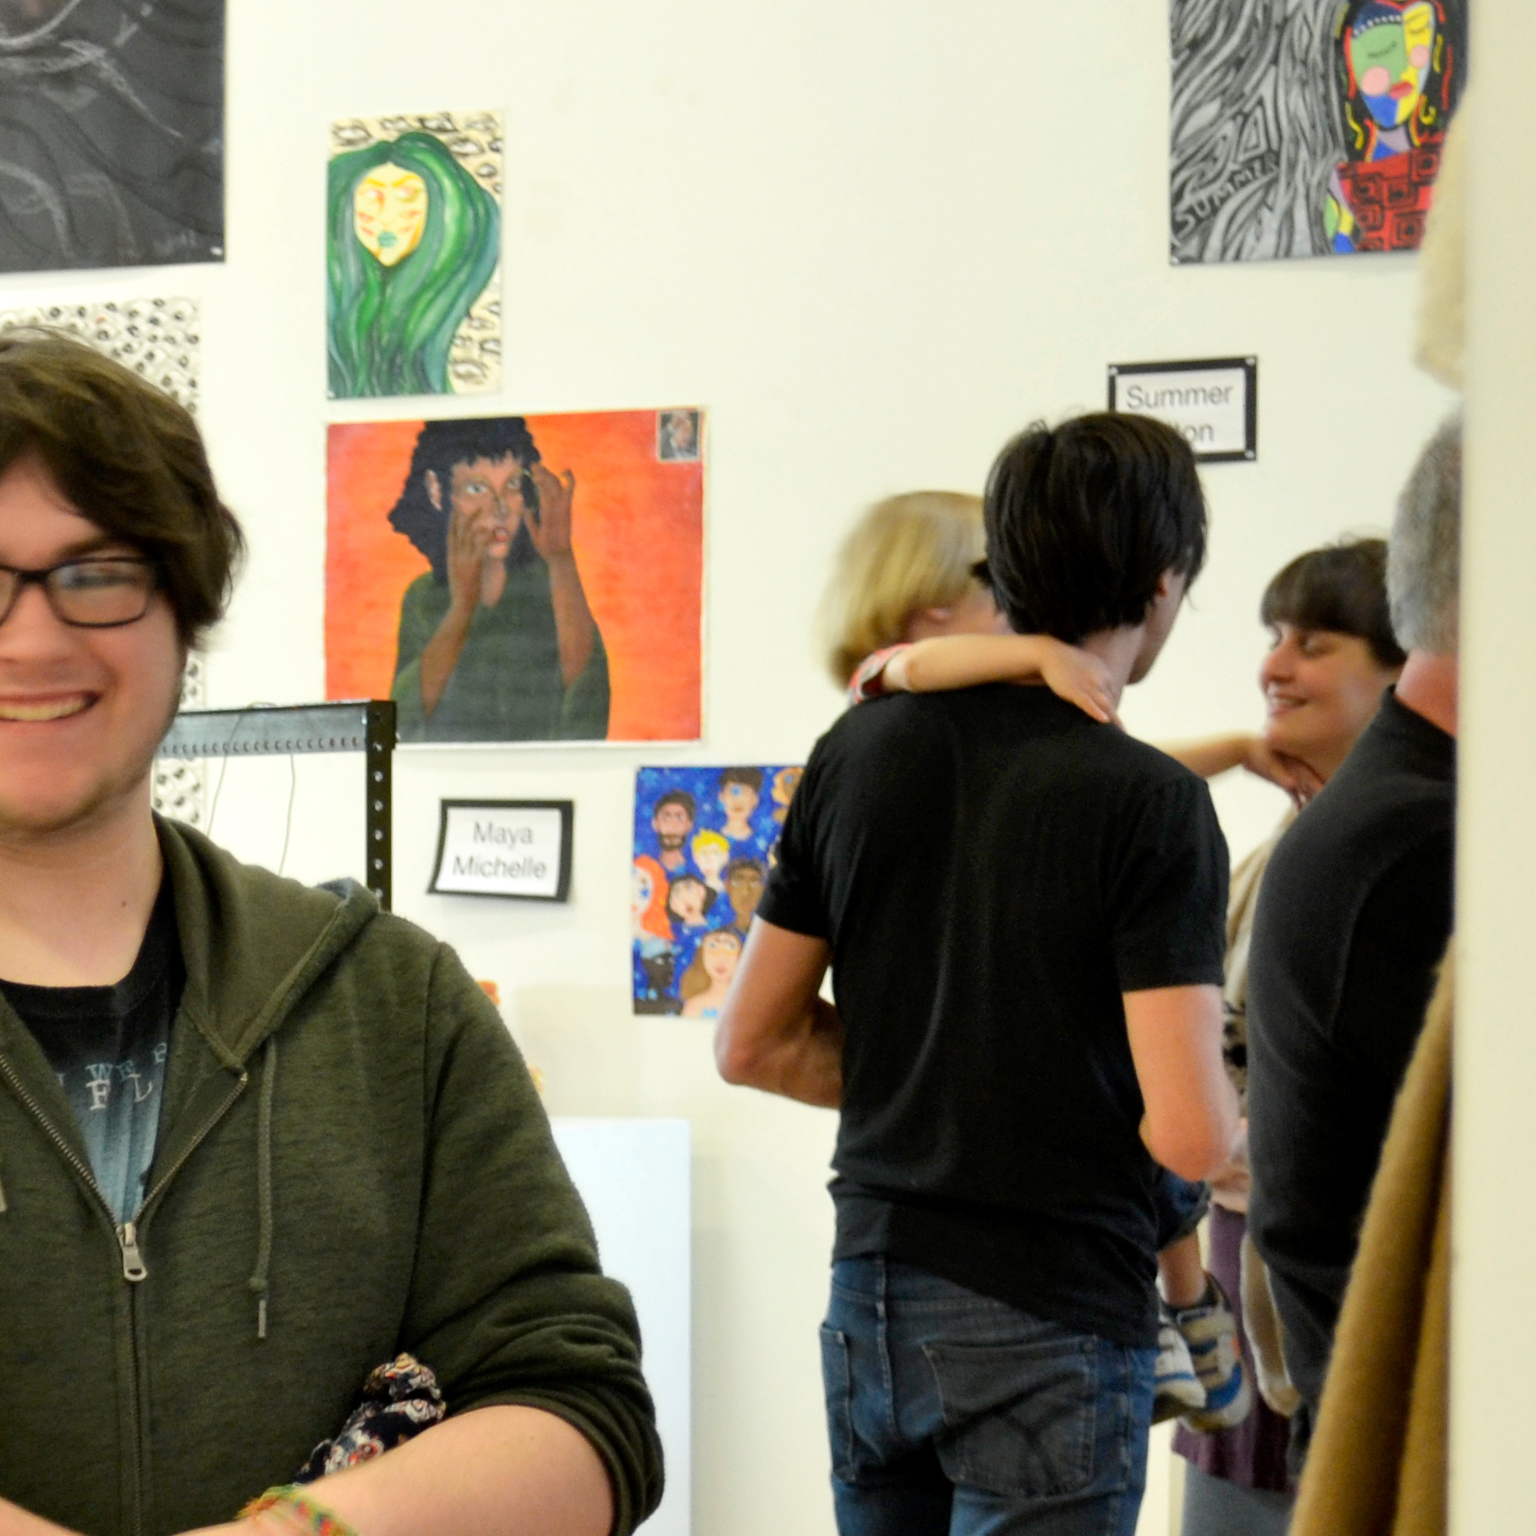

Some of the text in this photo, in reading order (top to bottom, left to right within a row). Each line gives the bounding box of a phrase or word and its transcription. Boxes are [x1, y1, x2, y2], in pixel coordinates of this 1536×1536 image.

[1126, 384, 1233, 409] Summer
[472, 820, 534, 851] Maya
[451, 855, 547, 879] Michelle
